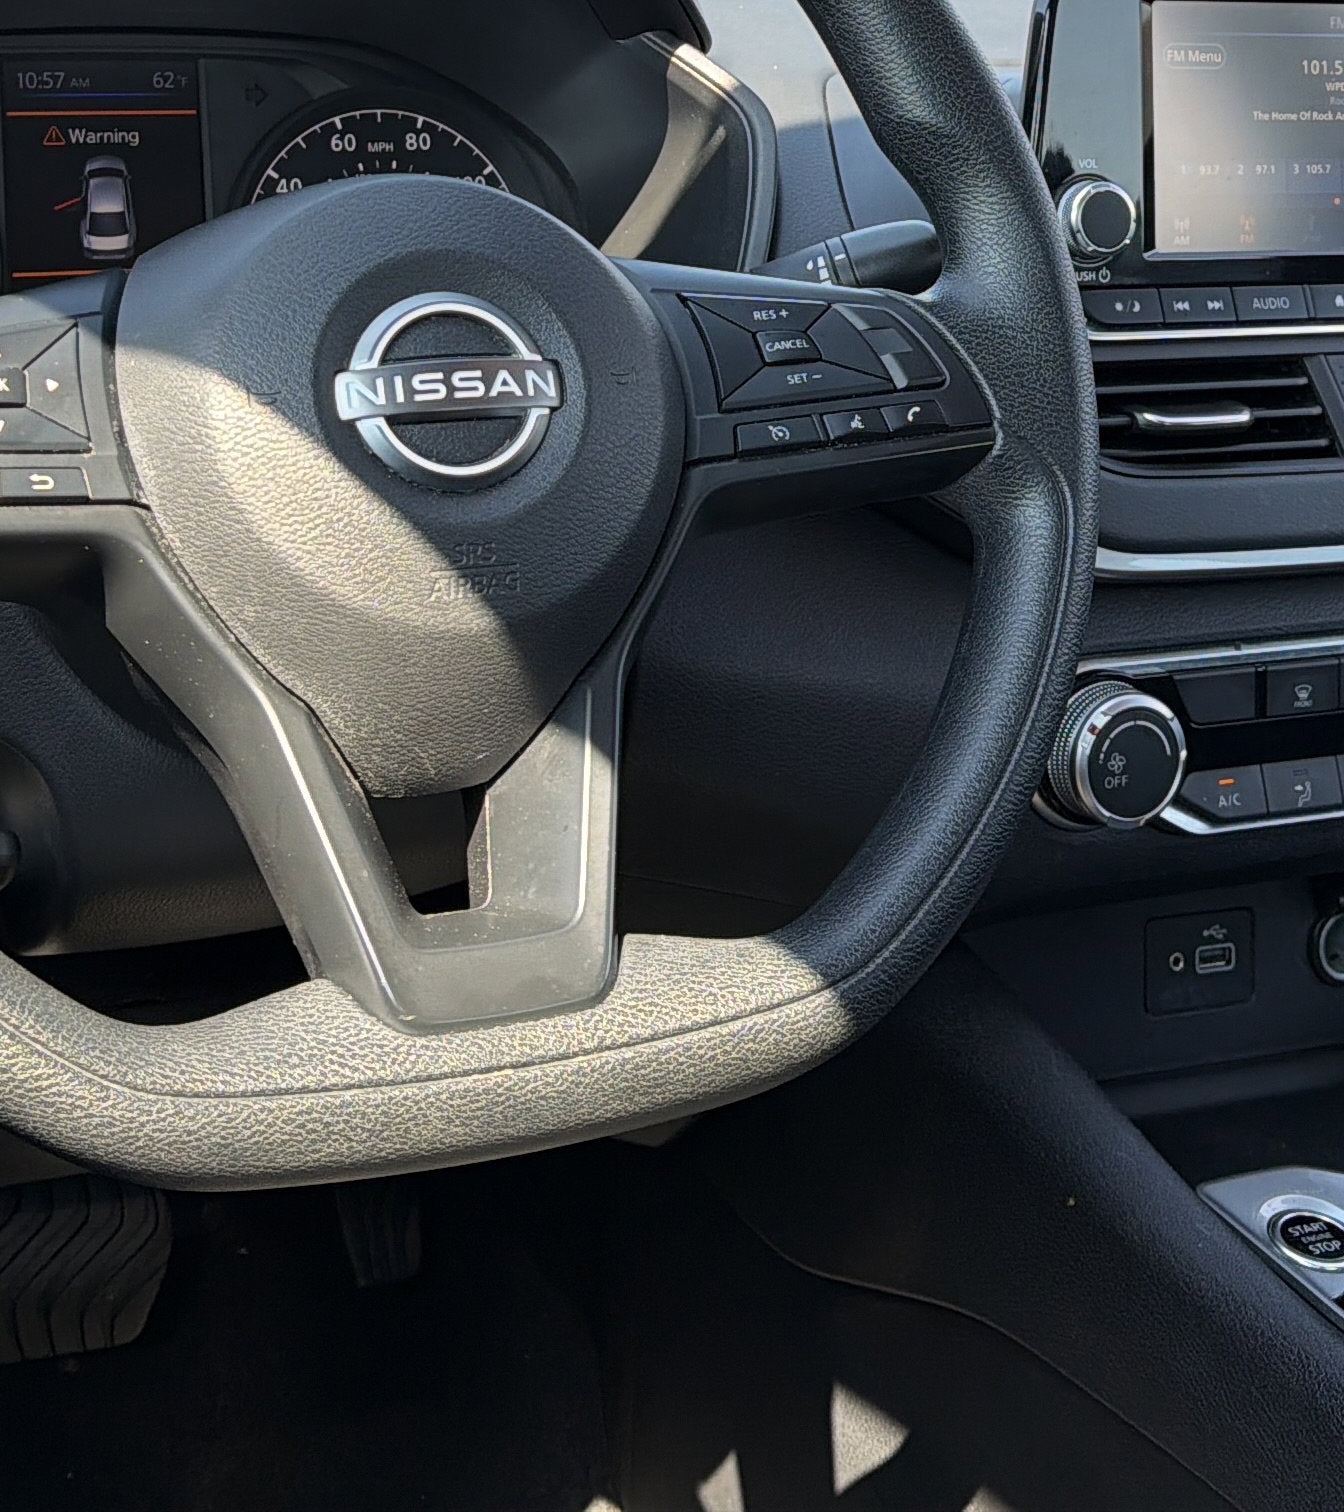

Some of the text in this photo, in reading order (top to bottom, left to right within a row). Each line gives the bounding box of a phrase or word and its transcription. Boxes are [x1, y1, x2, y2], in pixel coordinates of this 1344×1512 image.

[1166, 49, 1222, 63] FM Menu
[1302, 59, 1344, 75] 101.5
[17, 71, 91, 89] 10:57 AM
[1253, 111, 1269, 122] The
[1272, 111, 1298, 122] Home
[1300, 111, 1311, 122] Of
[1313, 111, 1333, 122] Rock
[68, 128, 140, 147] Warning
[331, 133, 357, 152] 60
[405, 132, 431, 151] 80
[368, 141, 394, 153] MPH
[1079, 158, 1098, 169] VOL
[1255, 164, 1276, 175] 97.1
[1293, 164, 1300, 175] 3
[1306, 164, 1331, 175] 105.7
[1174, 236, 1190, 246] AM
[1252, 295, 1290, 311] AUDIO
[753, 309, 777, 321] RES
[765, 338, 810, 352] CANCEL
[786, 372, 808, 385] SET
[346, 368, 557, 409] NISSAN
[1104, 774, 1129, 789] OFF
[1218, 792, 1242, 808] A/C
[1287, 1222, 1329, 1237] START
[1308, 1240, 1342, 1255] STOP
